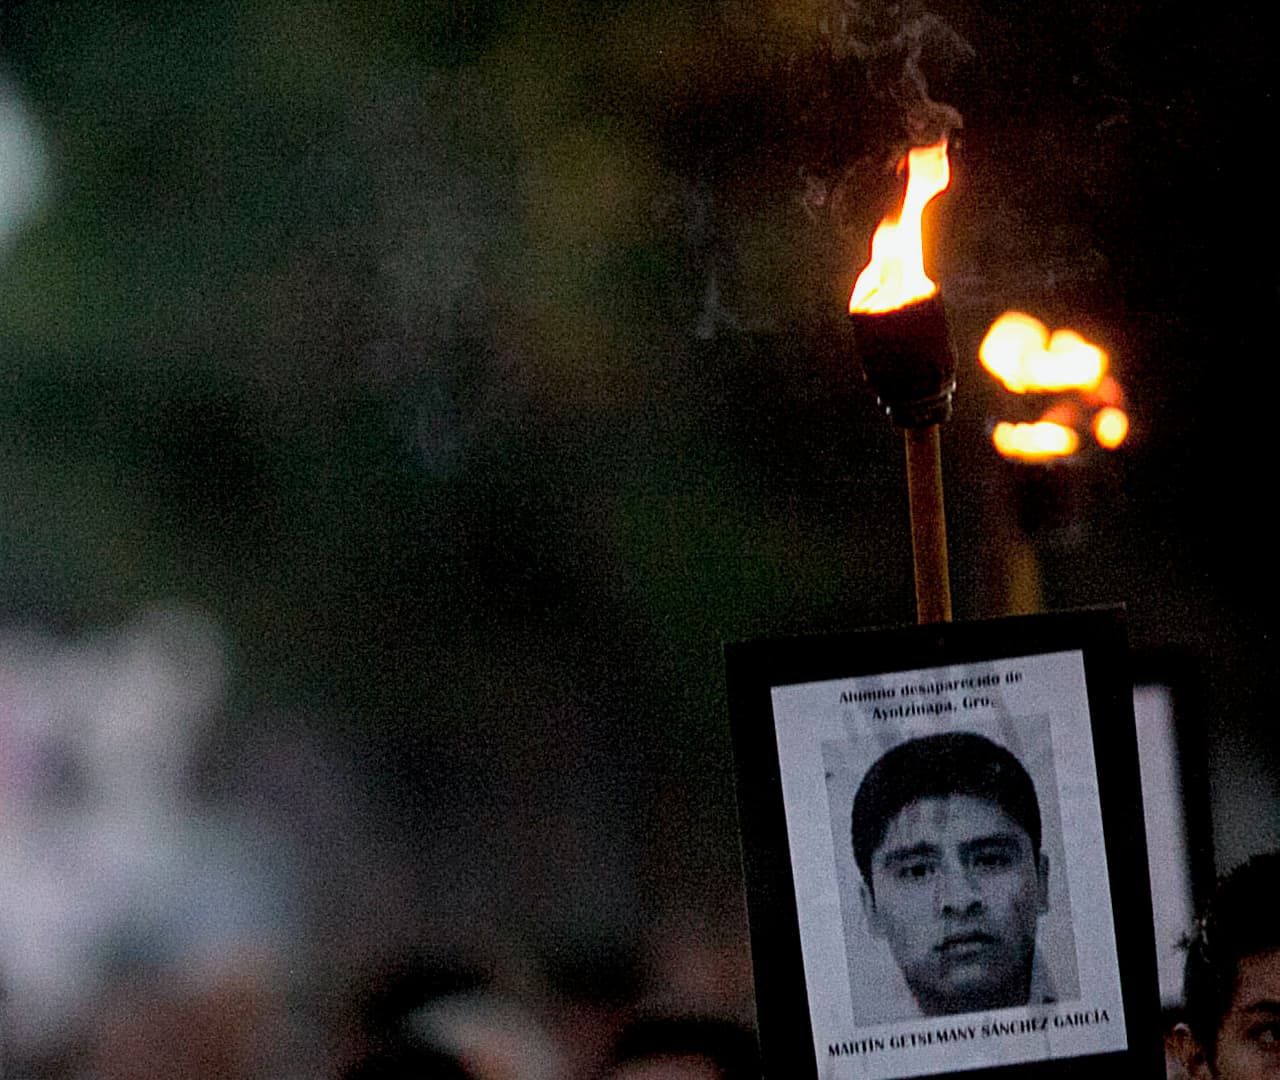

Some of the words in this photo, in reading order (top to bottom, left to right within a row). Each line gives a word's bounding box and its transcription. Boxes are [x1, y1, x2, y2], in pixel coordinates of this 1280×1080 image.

[840, 687, 896, 704] Alumno
[901, 673, 1001, 698] desaparecido
[1005, 670, 1023, 684] de
[872, 701, 958, 721] Ayotzinapa,
[963, 694, 994, 710] Gro.
[828, 1037, 885, 1056] MARTÍN
[890, 1026, 977, 1049] GETSEMANY
[981, 1018, 1048, 1038] SÁNCHEZ
[1054, 1009, 1111, 1028] GARCÍA
